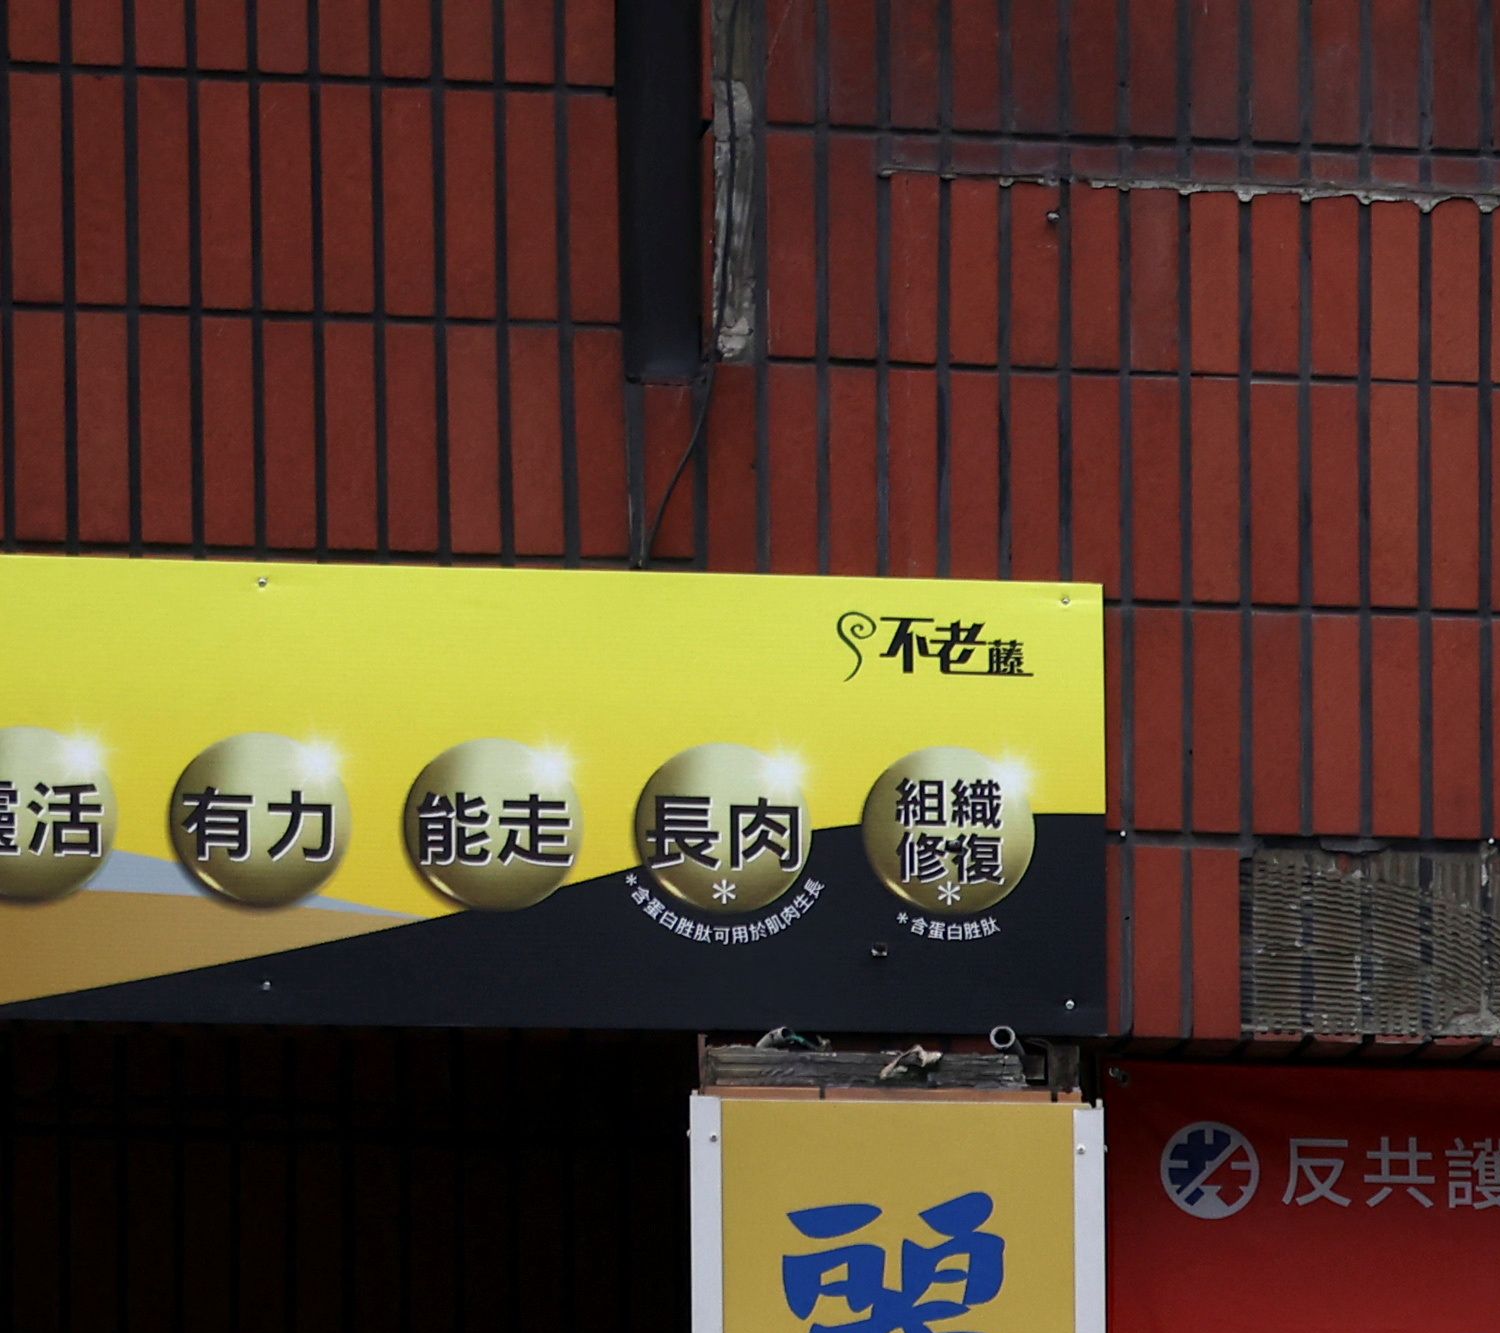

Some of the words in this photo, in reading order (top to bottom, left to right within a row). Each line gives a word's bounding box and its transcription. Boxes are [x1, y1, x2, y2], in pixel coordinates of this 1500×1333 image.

[879, 616, 1034, 676] 不老藤
[0, 780, 104, 857] 活
[181, 786, 337, 862] 有力
[417, 792, 574, 867] 能走
[645, 795, 802, 872] 長肉
[896, 777, 1004, 829] 組織
[896, 831, 1005, 886] 修復
